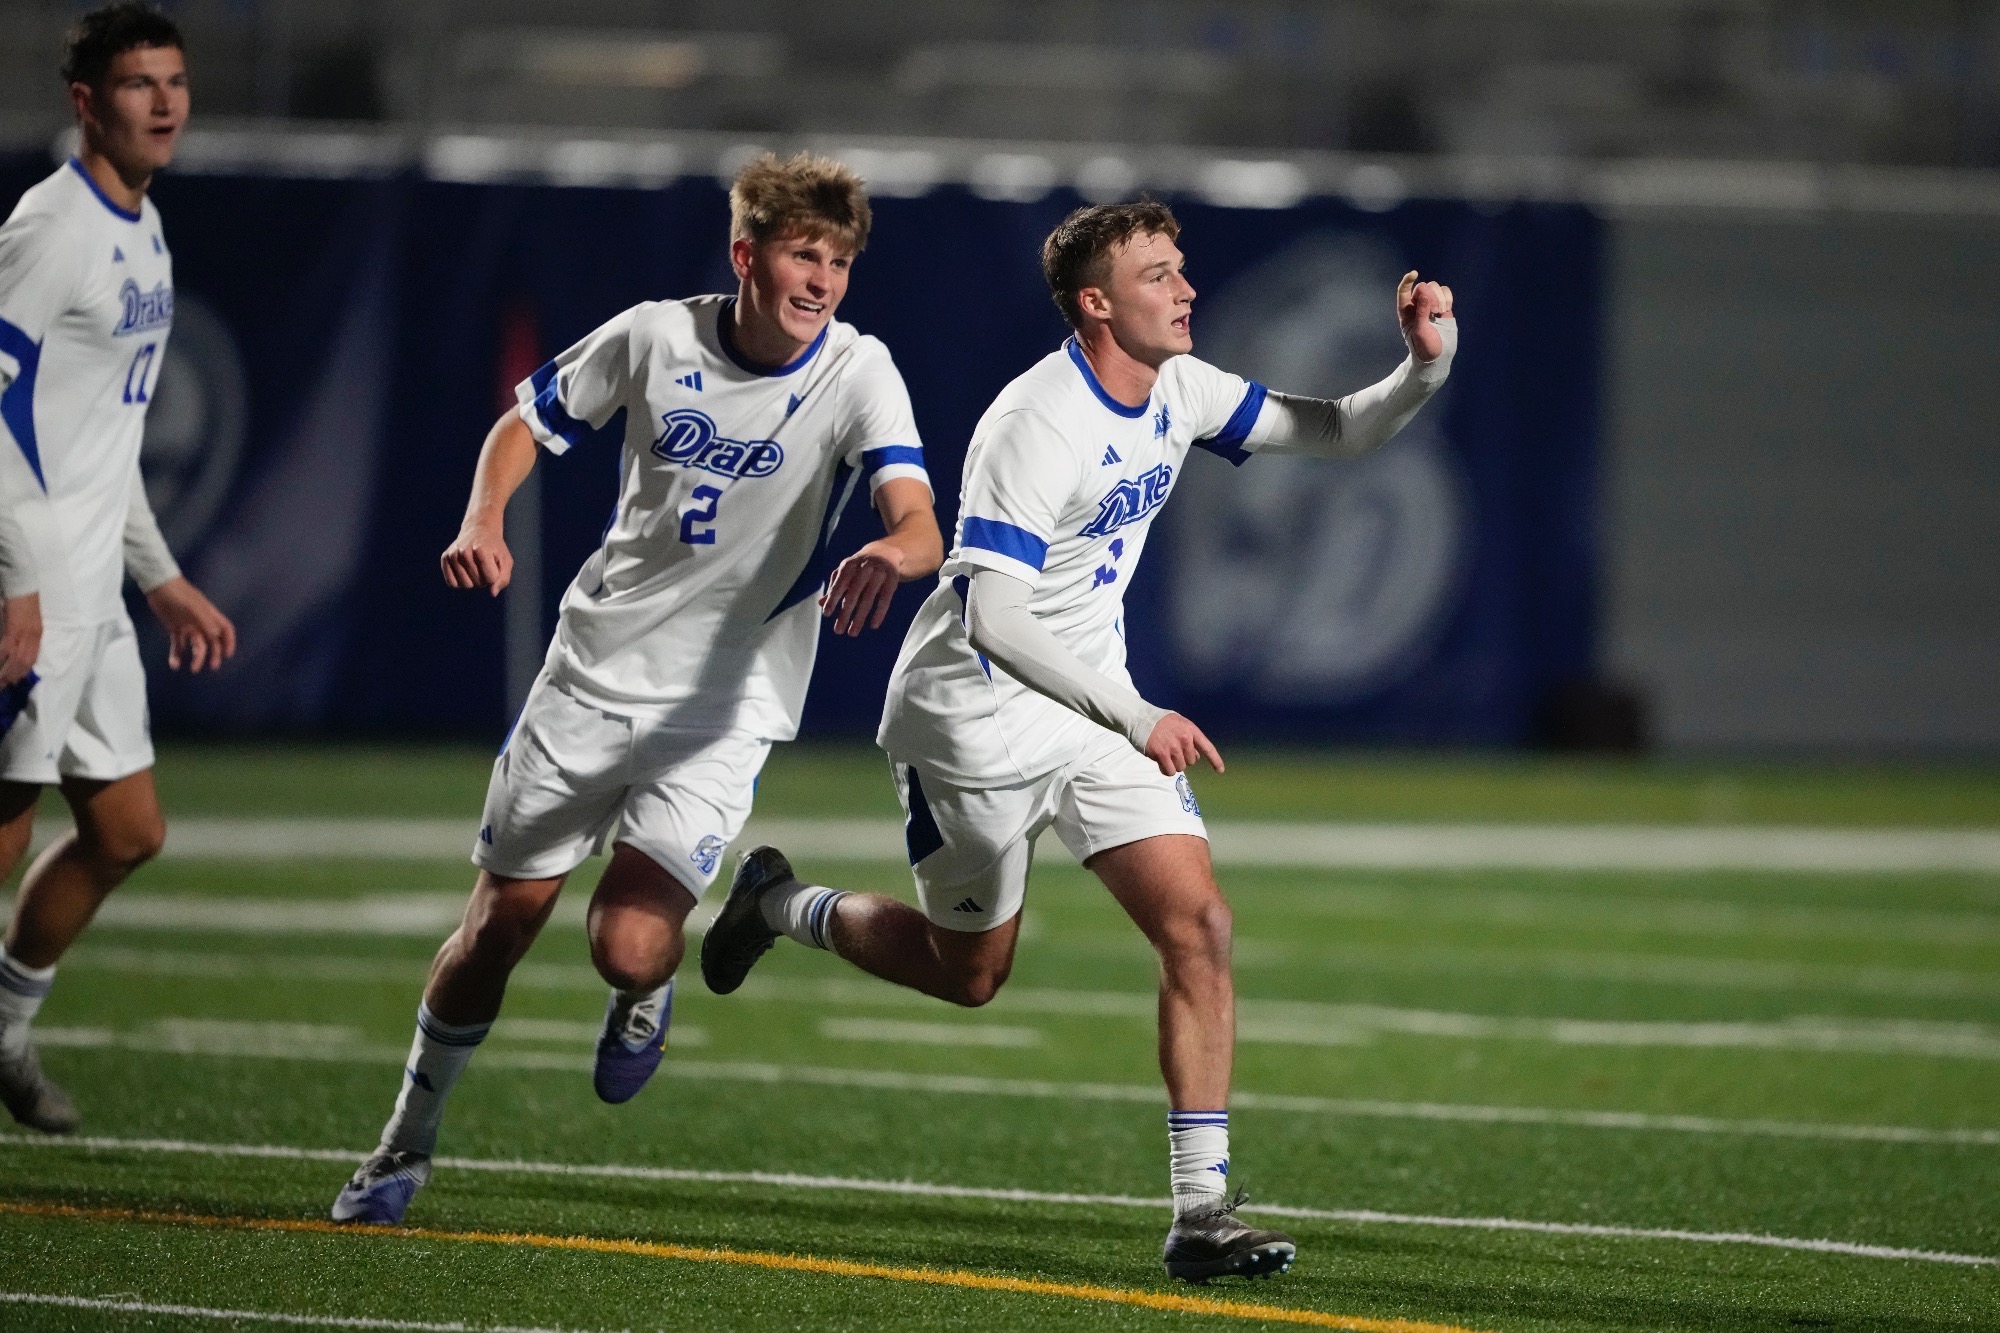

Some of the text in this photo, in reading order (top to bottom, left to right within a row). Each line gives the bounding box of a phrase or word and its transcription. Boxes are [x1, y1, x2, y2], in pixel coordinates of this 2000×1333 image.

[651, 408, 784, 480] Drae
[679, 484, 723, 545] 2
[1076, 462, 1173, 539] Dake
